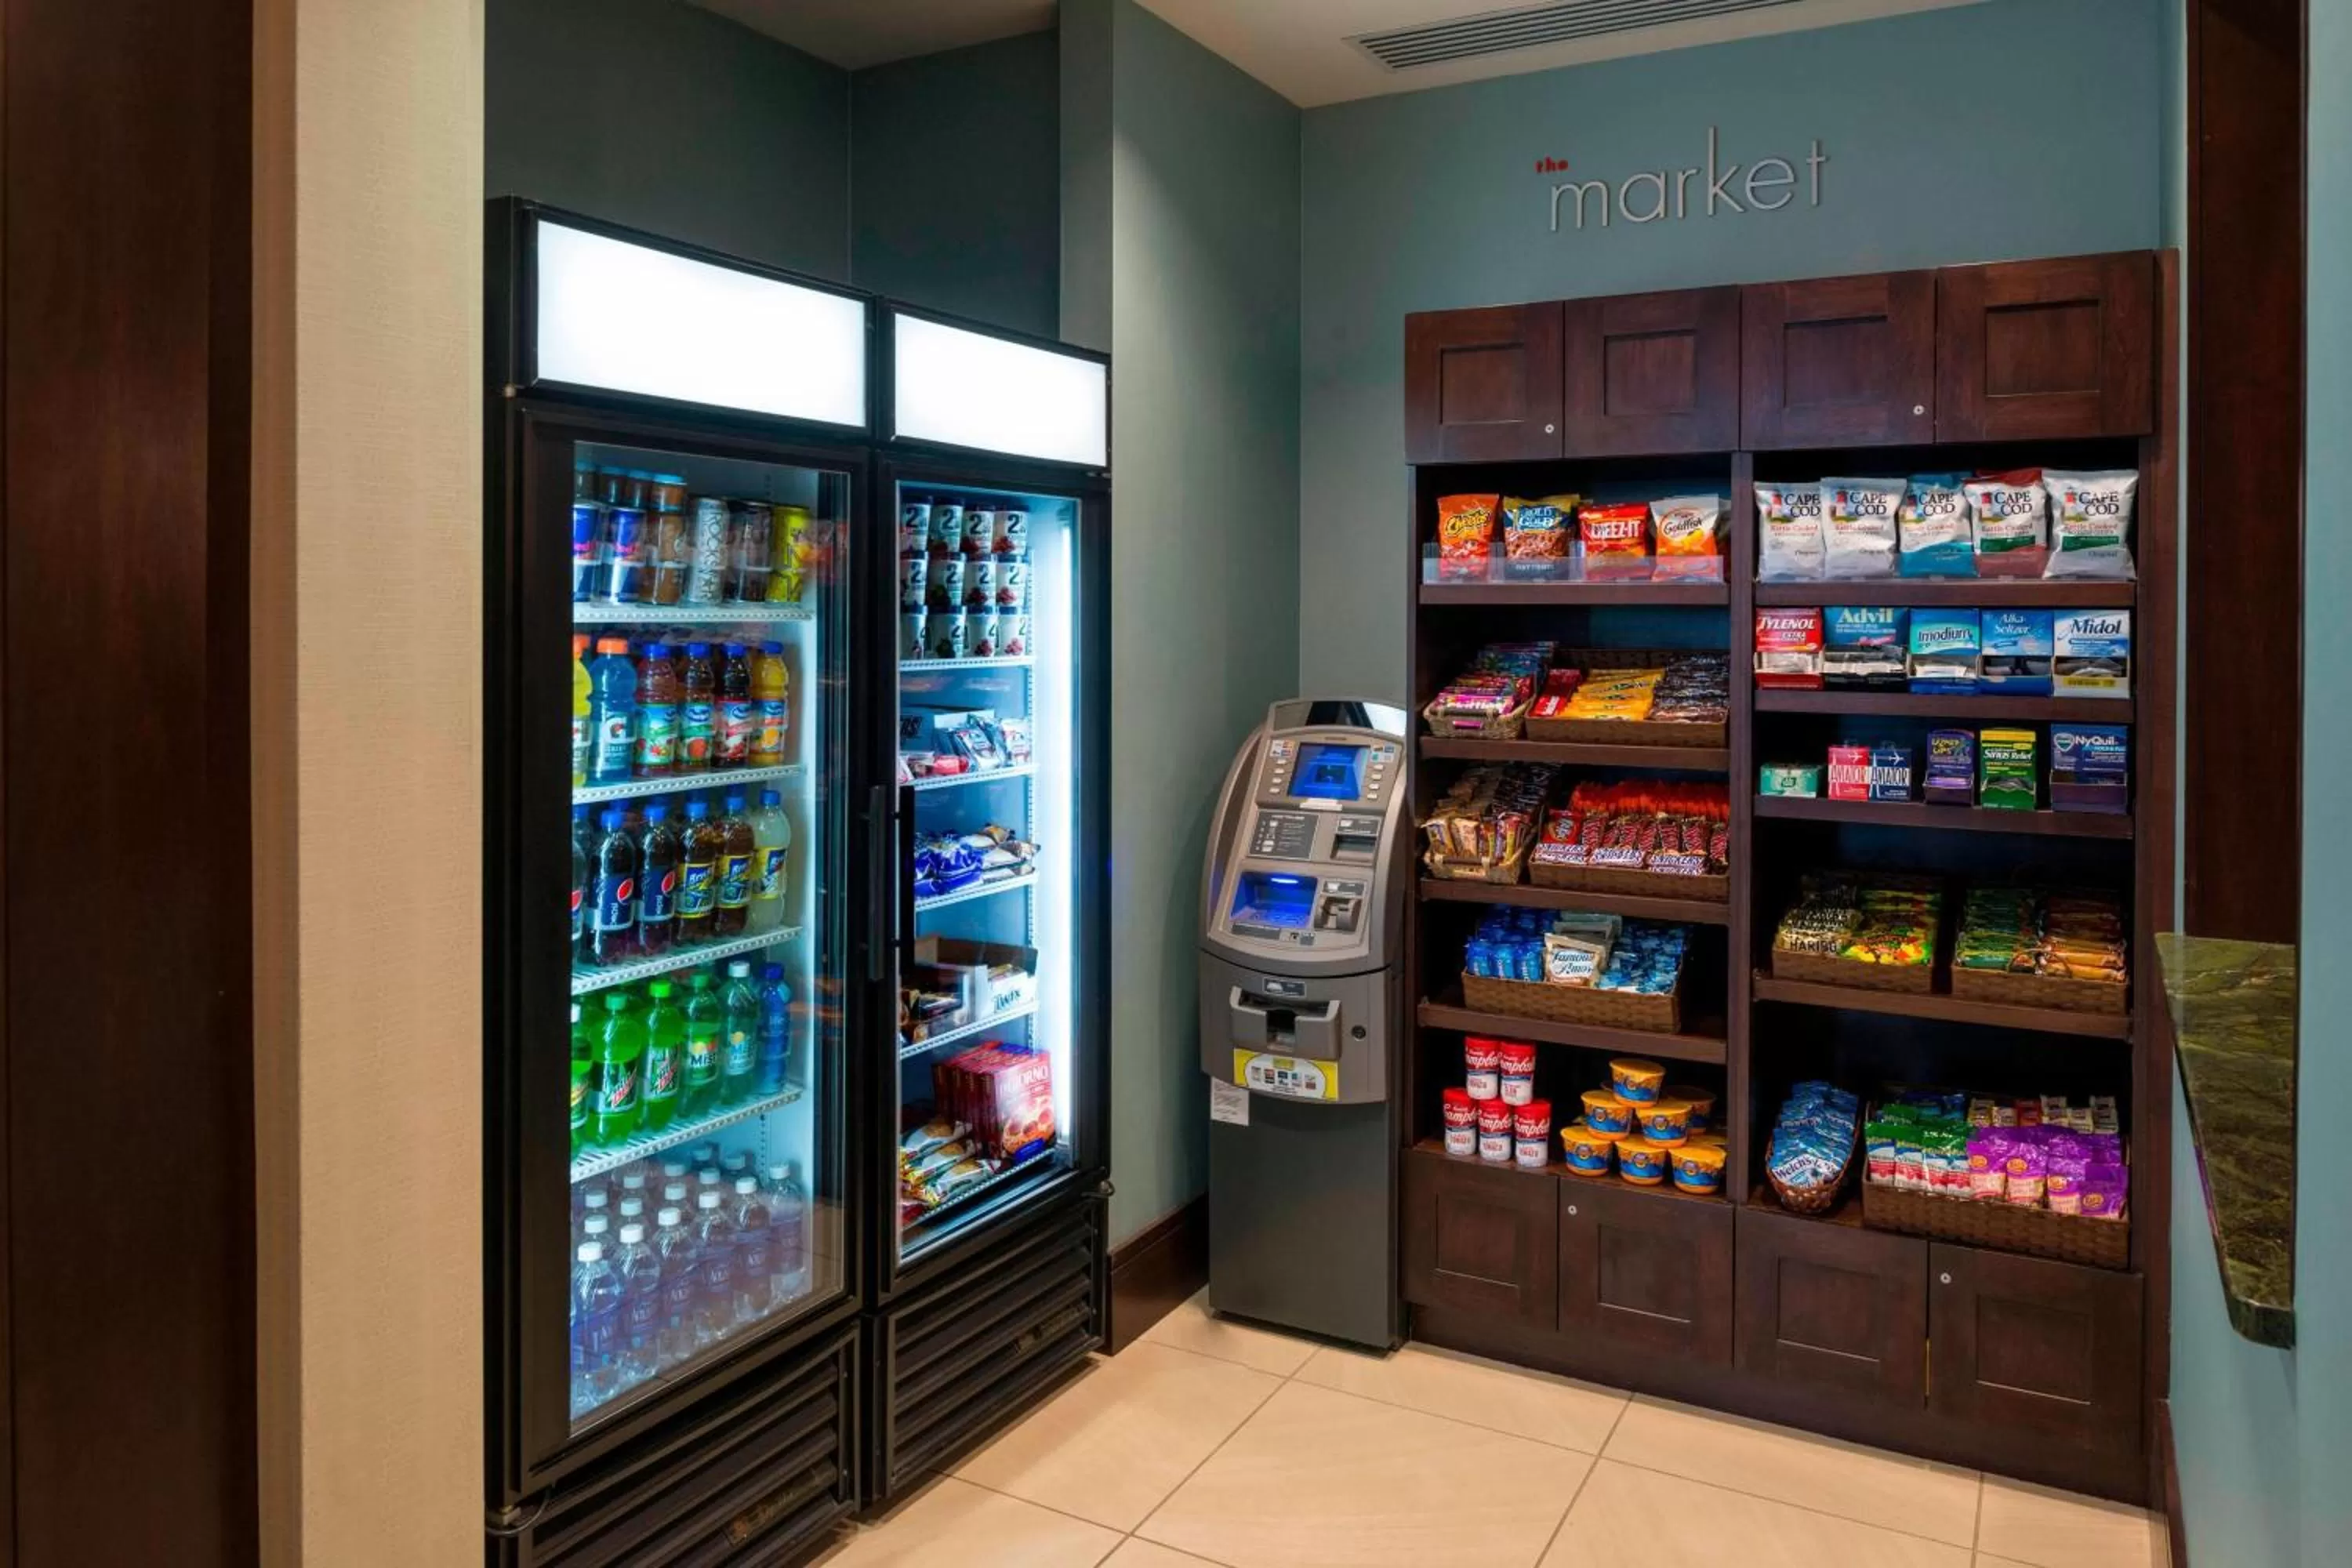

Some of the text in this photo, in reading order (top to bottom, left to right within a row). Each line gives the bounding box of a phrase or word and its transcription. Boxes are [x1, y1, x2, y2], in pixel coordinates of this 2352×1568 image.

[1536, 156, 1568, 173] the
[1550, 125, 1828, 232] market
[1784, 493, 1820, 506] CAPE
[1850, 492, 1887, 504] CAPE
[1919, 492, 1954, 505] CAPE
[1994, 492, 2031, 505] CAPE
[2079, 491, 2119, 504] CAPE
[906, 507, 918, 528] 2
[1790, 506, 1820, 517] COD
[1854, 504, 1887, 516] COD
[1923, 503, 1955, 517] COD
[2001, 503, 2032, 516] COD
[2085, 503, 2119, 516] COD
[943, 510, 954, 530] 2
[969, 514, 982, 535] 2
[1007, 514, 1020, 534] 2
[1591, 520, 1640, 539] CHEEZ-IT
[911, 563, 921, 583] 2
[946, 564, 957, 584] 2
[979, 564, 989, 584] 2
[1009, 565, 1019, 585] 2
[1838, 608, 1894, 623] Advil
[1757, 616, 1816, 634] TYLENOL
[2071, 618, 2122, 634] Midol
[2075, 735, 2114, 747] NyQuil
